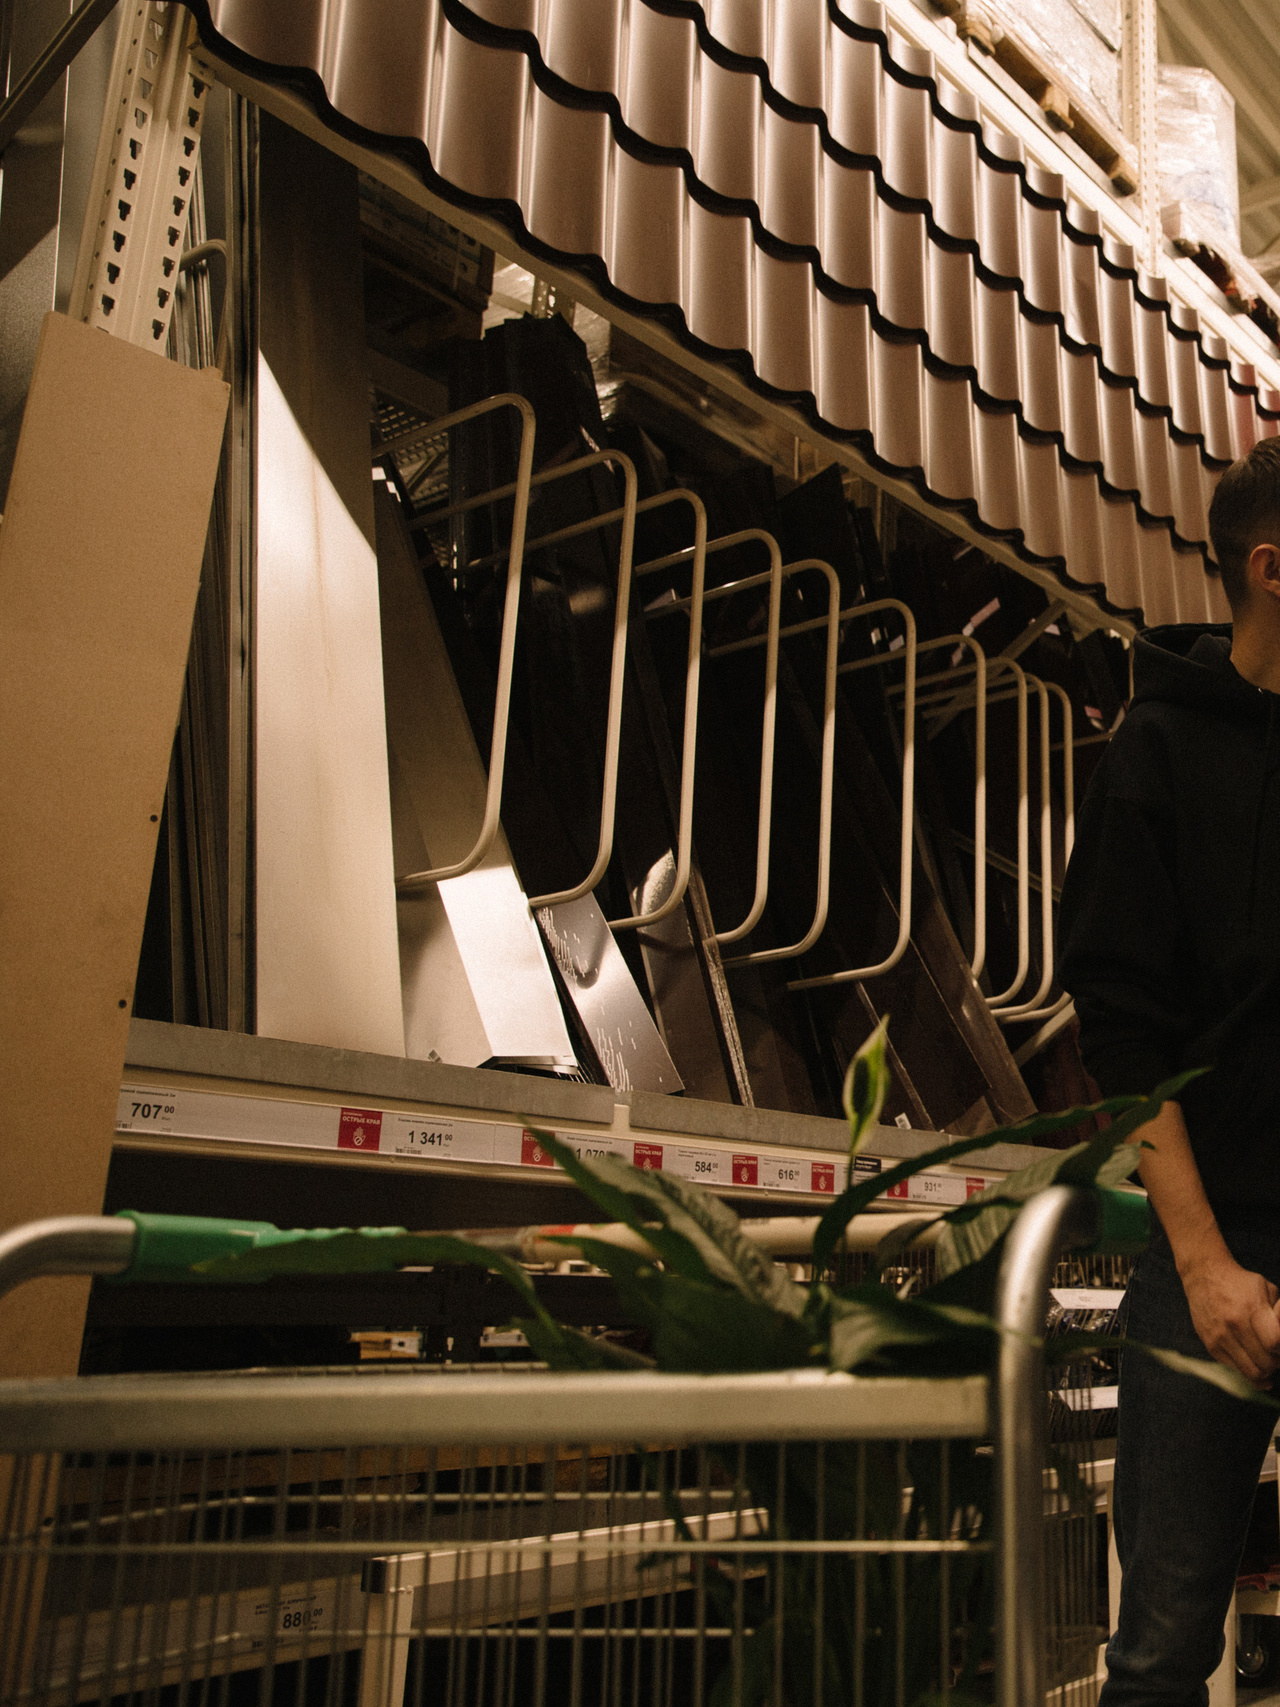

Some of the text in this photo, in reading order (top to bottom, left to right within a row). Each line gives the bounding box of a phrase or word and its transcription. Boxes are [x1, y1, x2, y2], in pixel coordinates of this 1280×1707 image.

[131, 1102, 175, 1119] 707 00
[420, 1131, 443, 1146] 341
[695, 1161, 712, 1173] 584
[778, 1169, 794, 1180] 616
